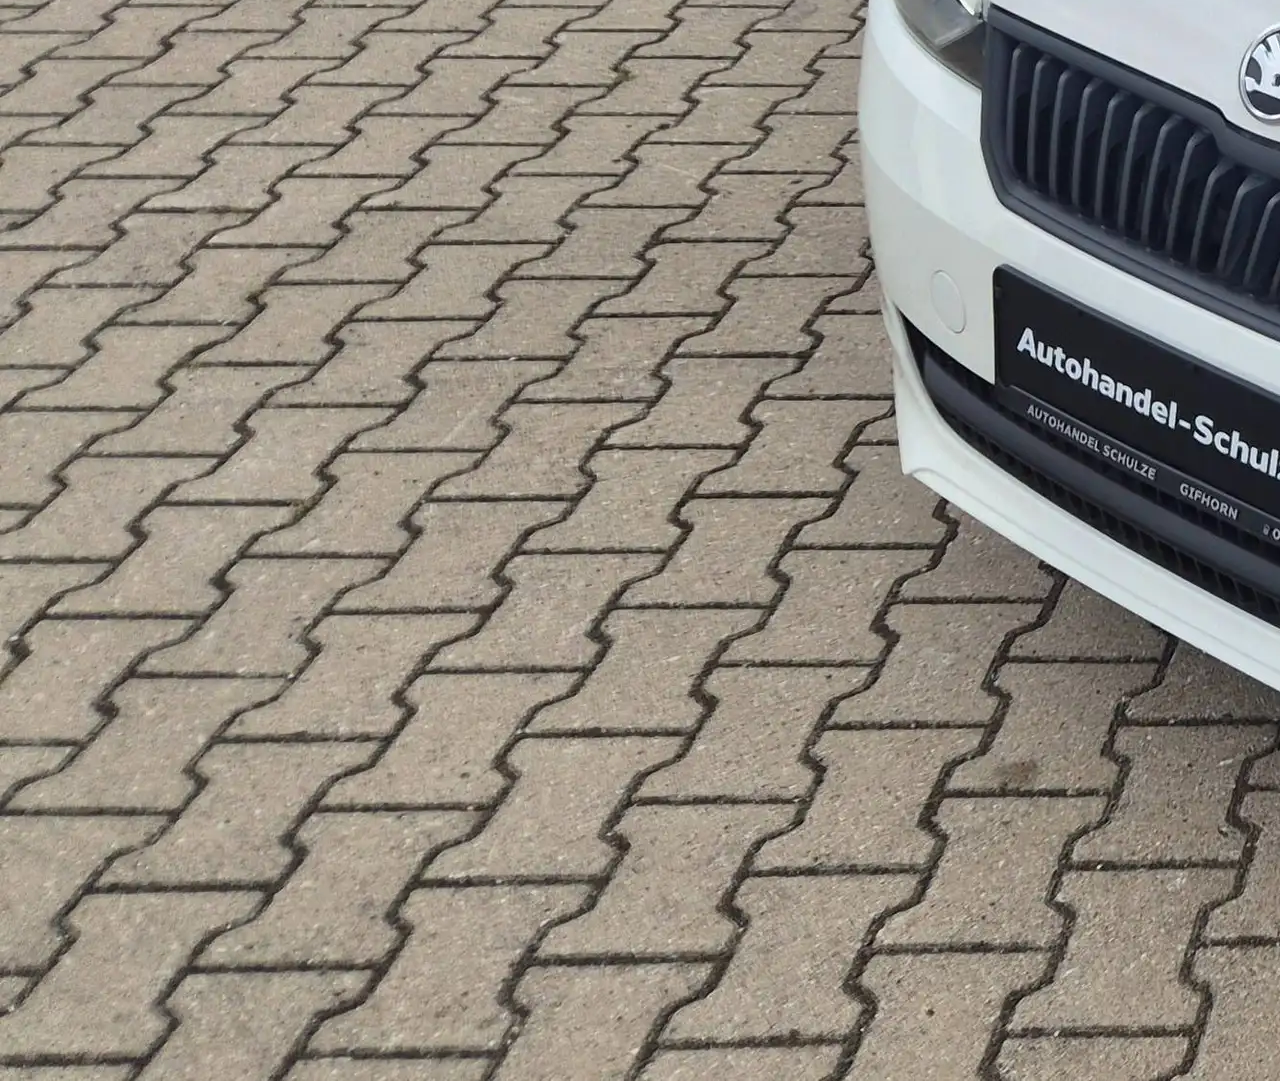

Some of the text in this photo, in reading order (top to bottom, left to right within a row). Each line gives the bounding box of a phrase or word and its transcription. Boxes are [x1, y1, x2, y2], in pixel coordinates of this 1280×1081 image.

[1027, 404, 1100, 452] AUTOHANDEL
[1100, 445, 1156, 481] SCHULZE
[1179, 482, 1239, 521] GIFHORN
